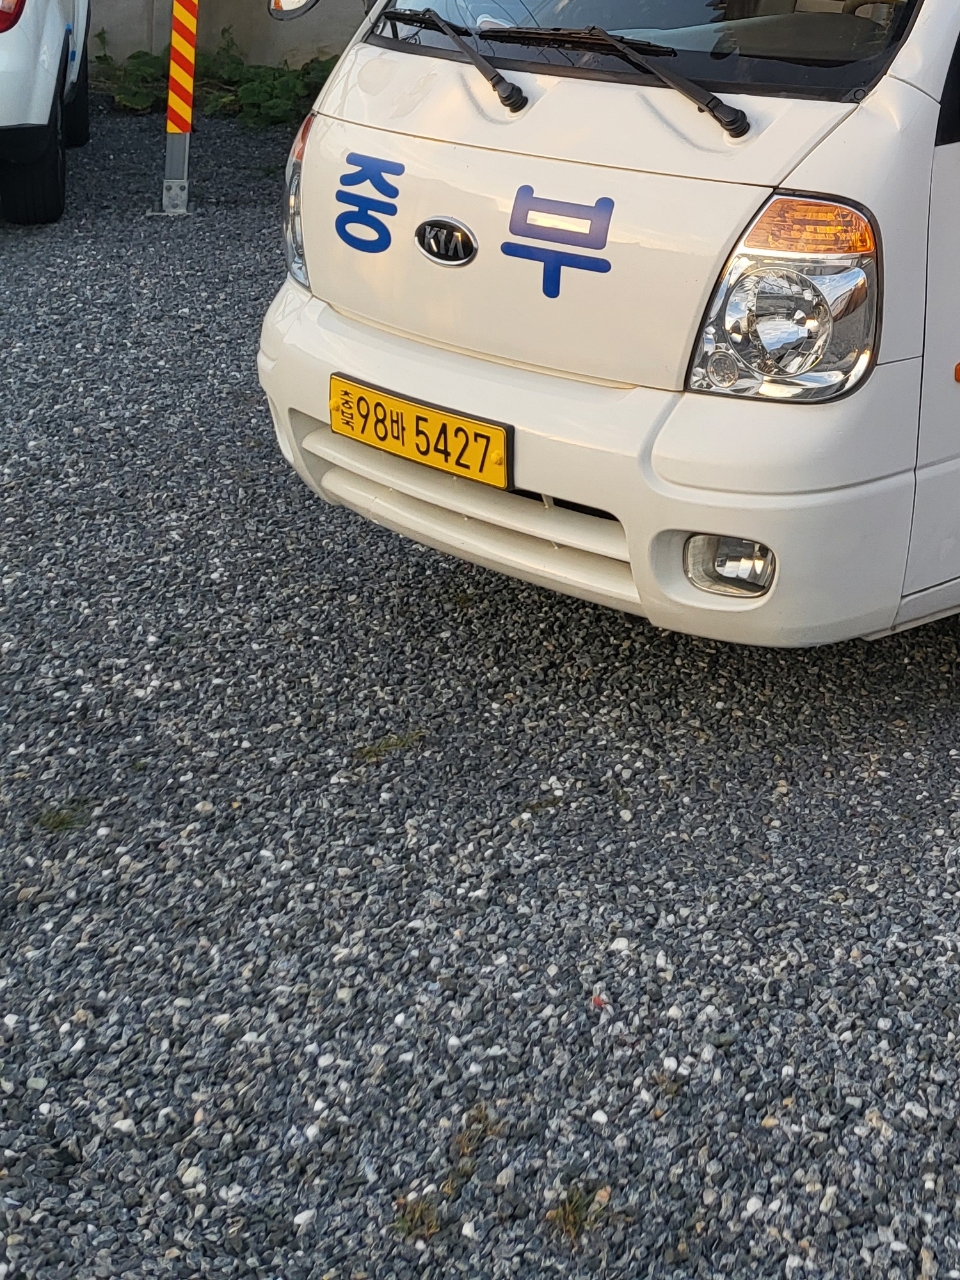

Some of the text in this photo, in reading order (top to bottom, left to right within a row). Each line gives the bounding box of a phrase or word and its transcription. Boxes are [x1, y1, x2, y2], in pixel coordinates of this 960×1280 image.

[335, 152, 615, 299] 중 부
[424, 225, 465, 258] KIA
[415, 414, 491, 473] 5427
